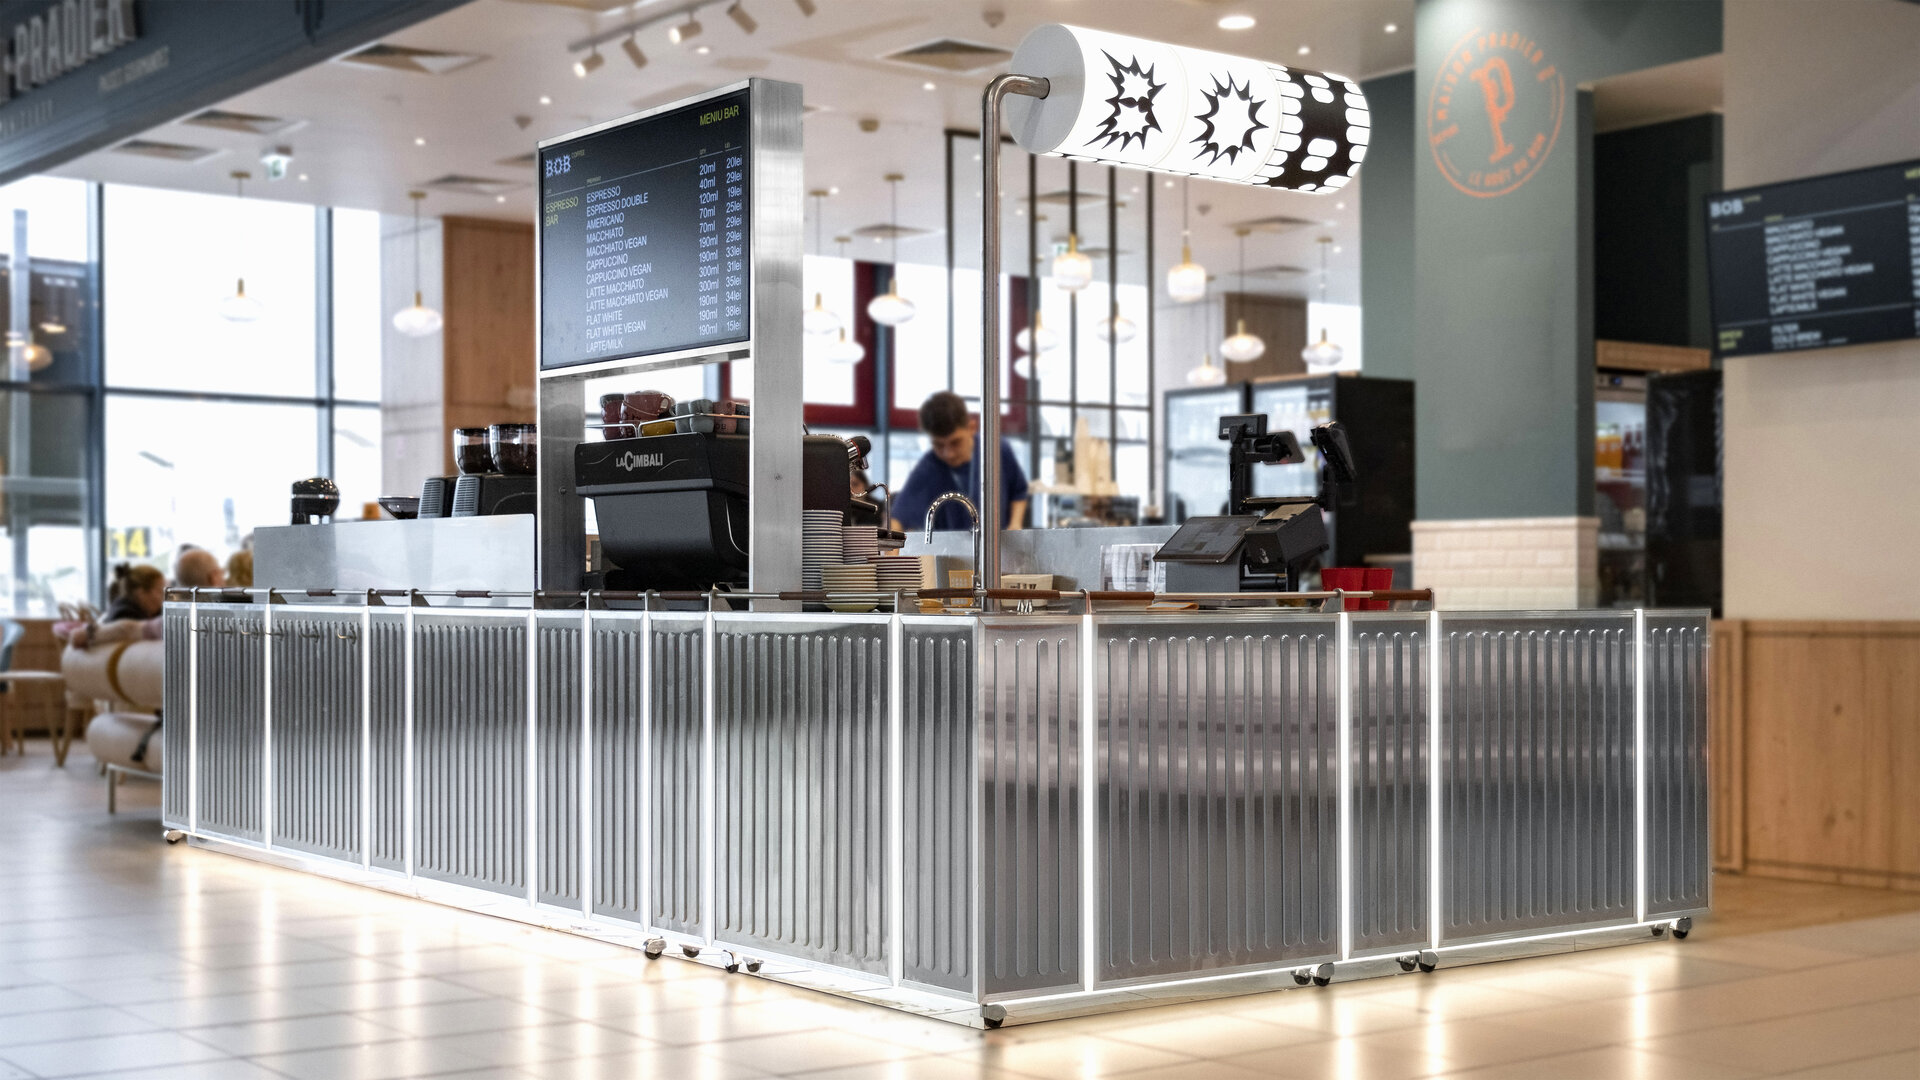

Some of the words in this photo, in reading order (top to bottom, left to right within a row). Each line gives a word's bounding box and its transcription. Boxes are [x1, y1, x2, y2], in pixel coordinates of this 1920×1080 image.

[699, 109, 723, 126] MENIU
[724, 105, 739, 120] BAR
[545, 154, 571, 178] BOB
[699, 161, 716, 176] 20ml
[726, 154, 742, 169] 20lei
[699, 175, 716, 189] 40ml
[726, 169, 742, 184] 29lei
[586, 186, 621, 203] ESPRESSO
[699, 190, 719, 204] 120ml
[727, 184, 742, 198] 19lei
[545, 196, 579, 213] ESPRESSO
[586, 200, 620, 217] ESPRESSO
[621, 192, 648, 209] DOUBLE
[726, 199, 742, 214] 25lei
[1710, 199, 1744, 218] BOB
[699, 205, 716, 219] 70ml
[545, 214, 559, 227] BAR
[586, 212, 625, 230] AMERICANO
[699, 220, 716, 234] 70ml
[726, 214, 742, 228] 29lei
[586, 226, 624, 243] MACCHIATO
[699, 234, 719, 248] 190ml
[726, 229, 742, 243] 29lei
[586, 240, 624, 257] MACCHIATO
[624, 235, 647, 249] VEGAN
[726, 244, 742, 258] 33lei
[586, 253, 628, 271] CAPPUCCINO
[699, 249, 719, 263] 190ml
[699, 264, 719, 277] 300ml
[727, 259, 742, 272] 31lei
[586, 267, 628, 285] CAPPUCCINO
[628, 262, 652, 276] VEGAN
[699, 278, 719, 292] 300ml
[726, 274, 742, 288] 35lei
[586, 285, 605, 299] LATTE
[606, 278, 645, 295] MACCHIATO
[726, 289, 742, 302] 34lei
[586, 299, 605, 312] LATTE
[606, 292, 644, 308] MACCHIATO
[645, 288, 669, 301] VEGAN
[699, 293, 718, 306] 190ml
[699, 308, 718, 321] 190ml
[726, 304, 742, 317] 38lei
[586, 313, 601, 326] FLAT
[602, 310, 623, 323] WHITE
[586, 327, 601, 339] FLAT
[602, 323, 623, 336] WHITE
[623, 320, 646, 333] VEGAN
[699, 323, 718, 336] 190ml
[727, 320, 741, 331] 15lei
